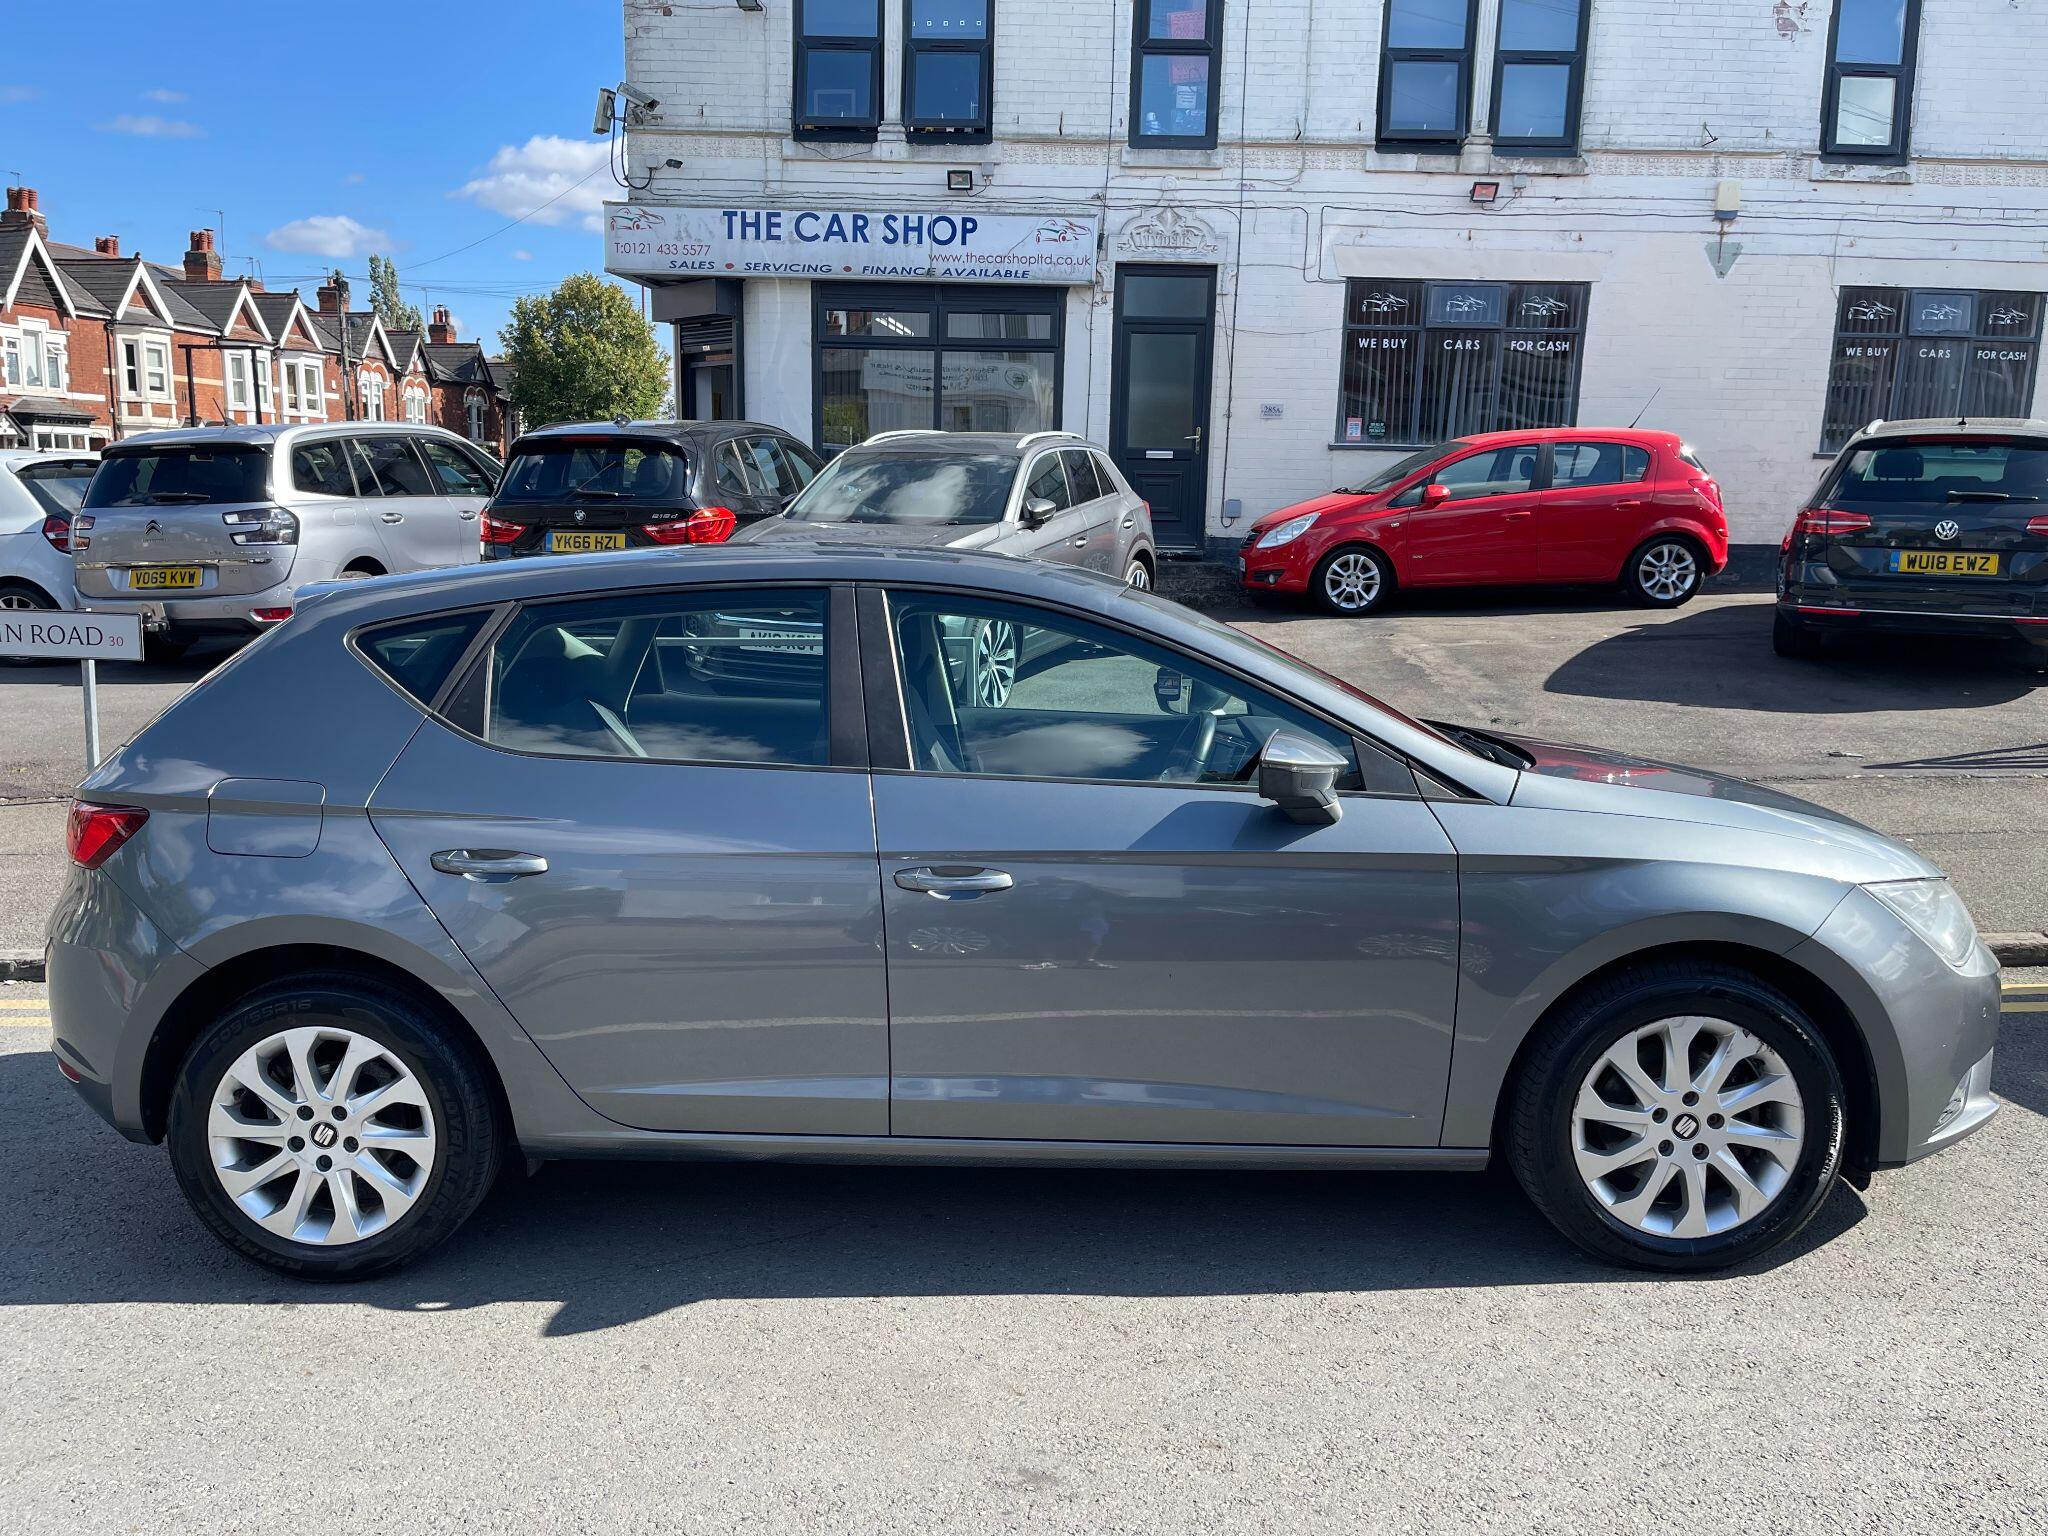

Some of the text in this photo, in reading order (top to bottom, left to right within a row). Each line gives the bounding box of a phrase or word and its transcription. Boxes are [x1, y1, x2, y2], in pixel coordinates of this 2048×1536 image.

[722, 210, 782, 241] THE
[794, 211, 870, 244] CAR
[881, 214, 978, 246] SHOP
[614, 242, 711, 257] T:0121 433 5577
[928, 251, 1091, 267] www.thecarshopltd.co.uk
[669, 260, 1031, 279] SALES SERVICING FINANCE AVAILABLE
[1358, 337, 1570, 352] WE BUY CARS FOR CASH
[1845, 347, 2027, 361] WE BUY CARS FOR CASH
[555, 535, 620, 550] YK66 HZL
[1906, 554, 1991, 571] WU18 EWZ
[135, 570, 196, 584] VO69 KVW
[0, 624, 124, 647] N ROAD 30
